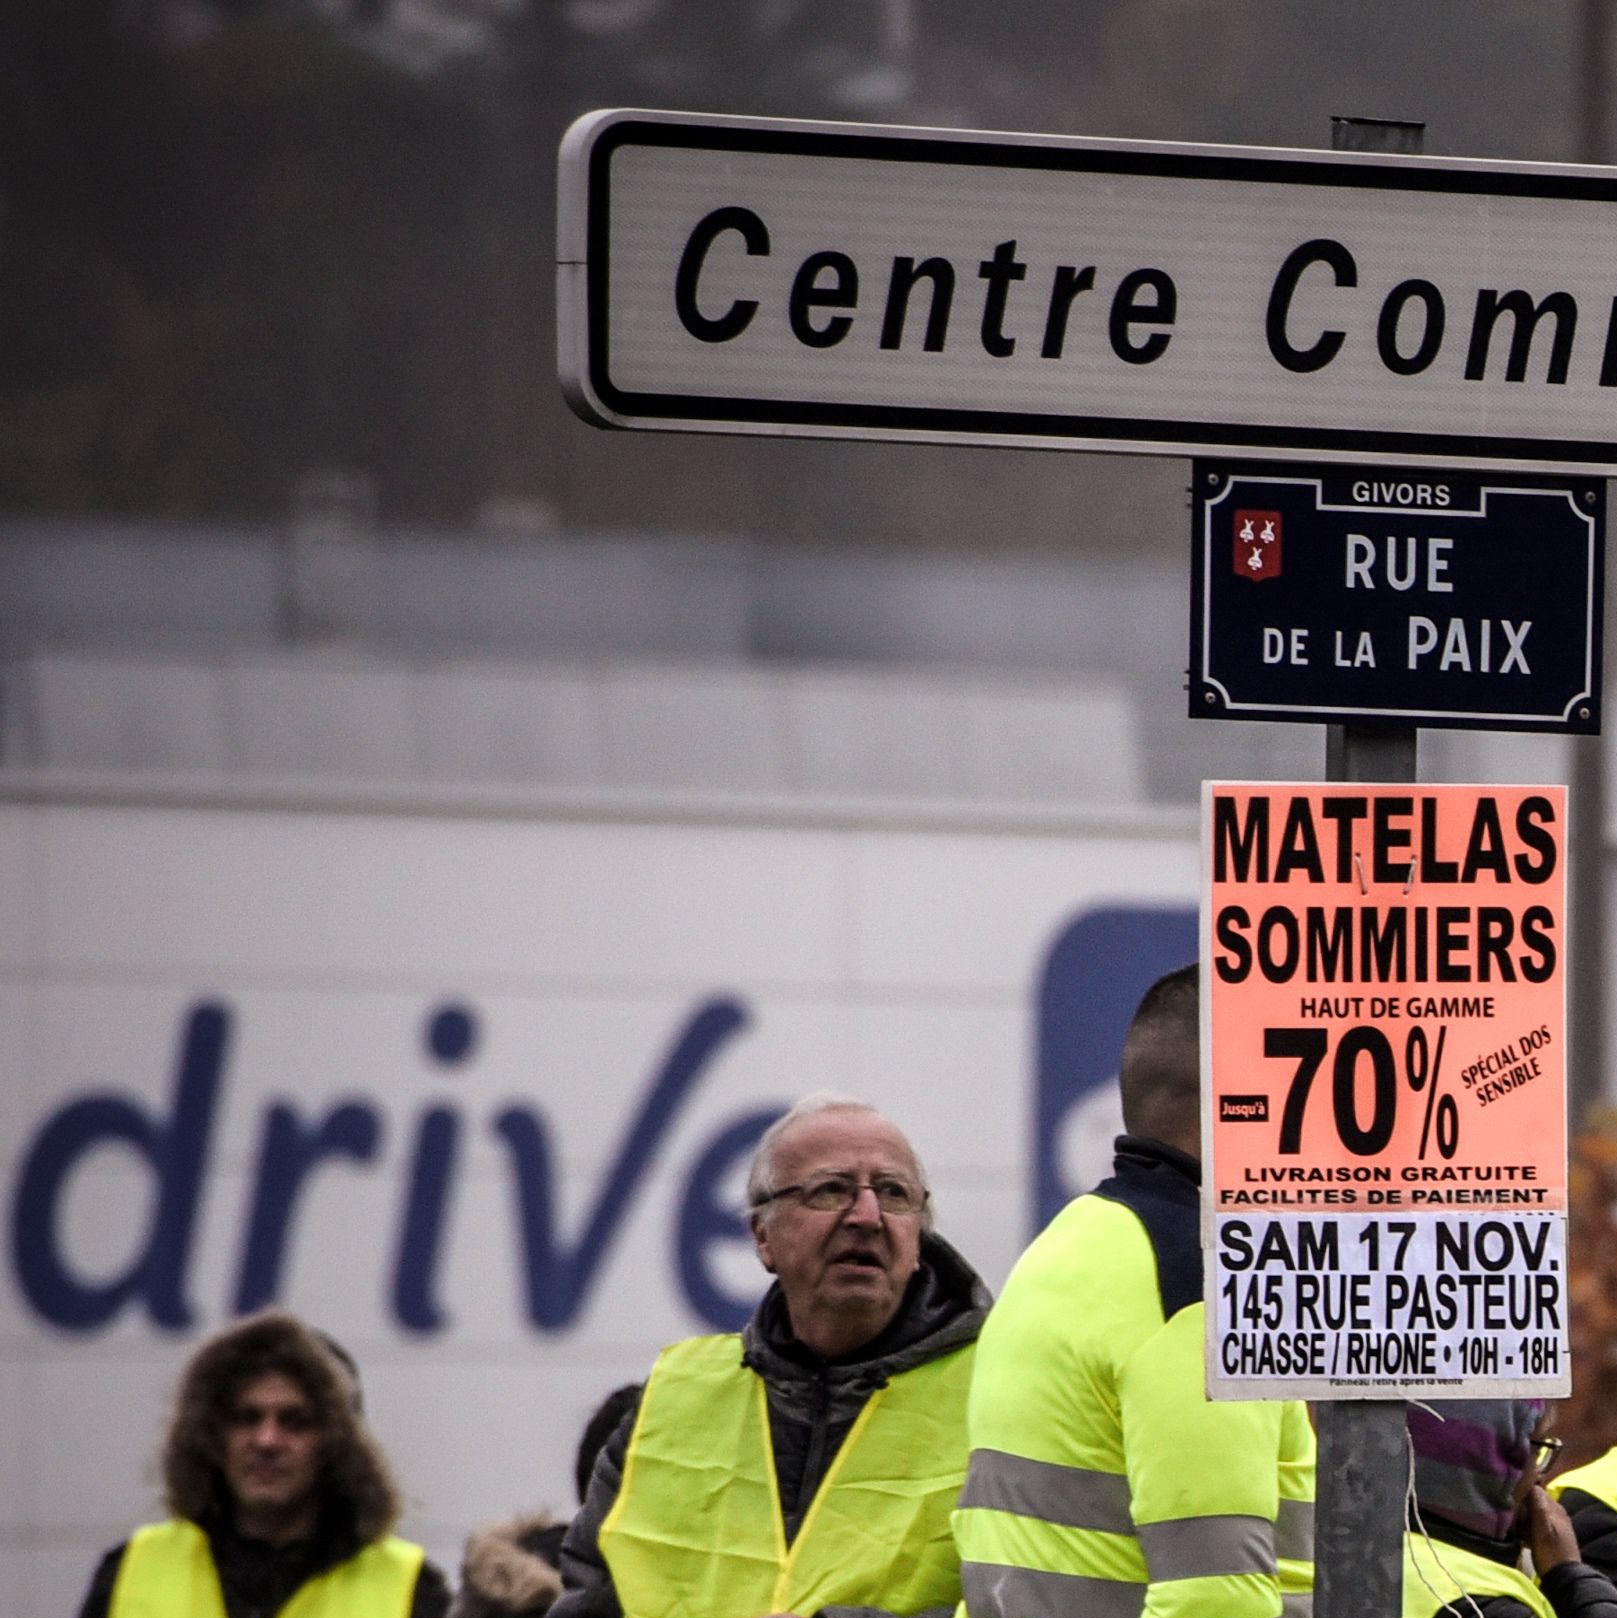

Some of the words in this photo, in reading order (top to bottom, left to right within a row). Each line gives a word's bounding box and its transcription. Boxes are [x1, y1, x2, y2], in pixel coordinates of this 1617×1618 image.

[674, 205, 1178, 366] Centre
[1351, 480, 1451, 506] GIVORS
[1345, 533, 1454, 593] RUE
[1263, 627, 1309, 666] DE
[1335, 630, 1376, 668] LA
[1407, 615, 1533, 675] PAIX
[1213, 796, 1558, 885] MATELAS
[1214, 905, 1557, 984] SOMMIERS
[1300, 997, 1365, 1019] HAUT
[1370, 997, 1401, 1019] DE
[1405, 997, 1496, 1019] GAMME
[1460, 1043, 1519, 1089] SPÉCIAL
[1521, 1024, 1552, 1057] DOS
[1475, 1057, 1543, 1107] SENSIBLE
[1222, 1101, 1265, 1118] Jusqu'à
[1220, 1188, 1358, 1205] FACILITES
[1366, 1189, 1402, 1206] DE
[1411, 1188, 1549, 1205] PAIEMENT
[1244, 1166, 1392, 1183] LIVRAISON
[1400, 1165, 1538, 1182] GRATUITE
[1219, 1220, 1340, 1272] SAM
[1358, 1221, 1417, 1272] 17
[1435, 1221, 1560, 1272] NOV.
[1222, 1274, 1284, 1331] 145
[1295, 1274, 1373, 1331] RUE
[1385, 1274, 1561, 1331] PASTEUR
[1222, 1332, 1326, 1376] CHASSE
[1346, 1332, 1437, 1375] RHONE
[1458, 1336, 1499, 1375] 10H
[1519, 1336, 1558, 1375] 18H
